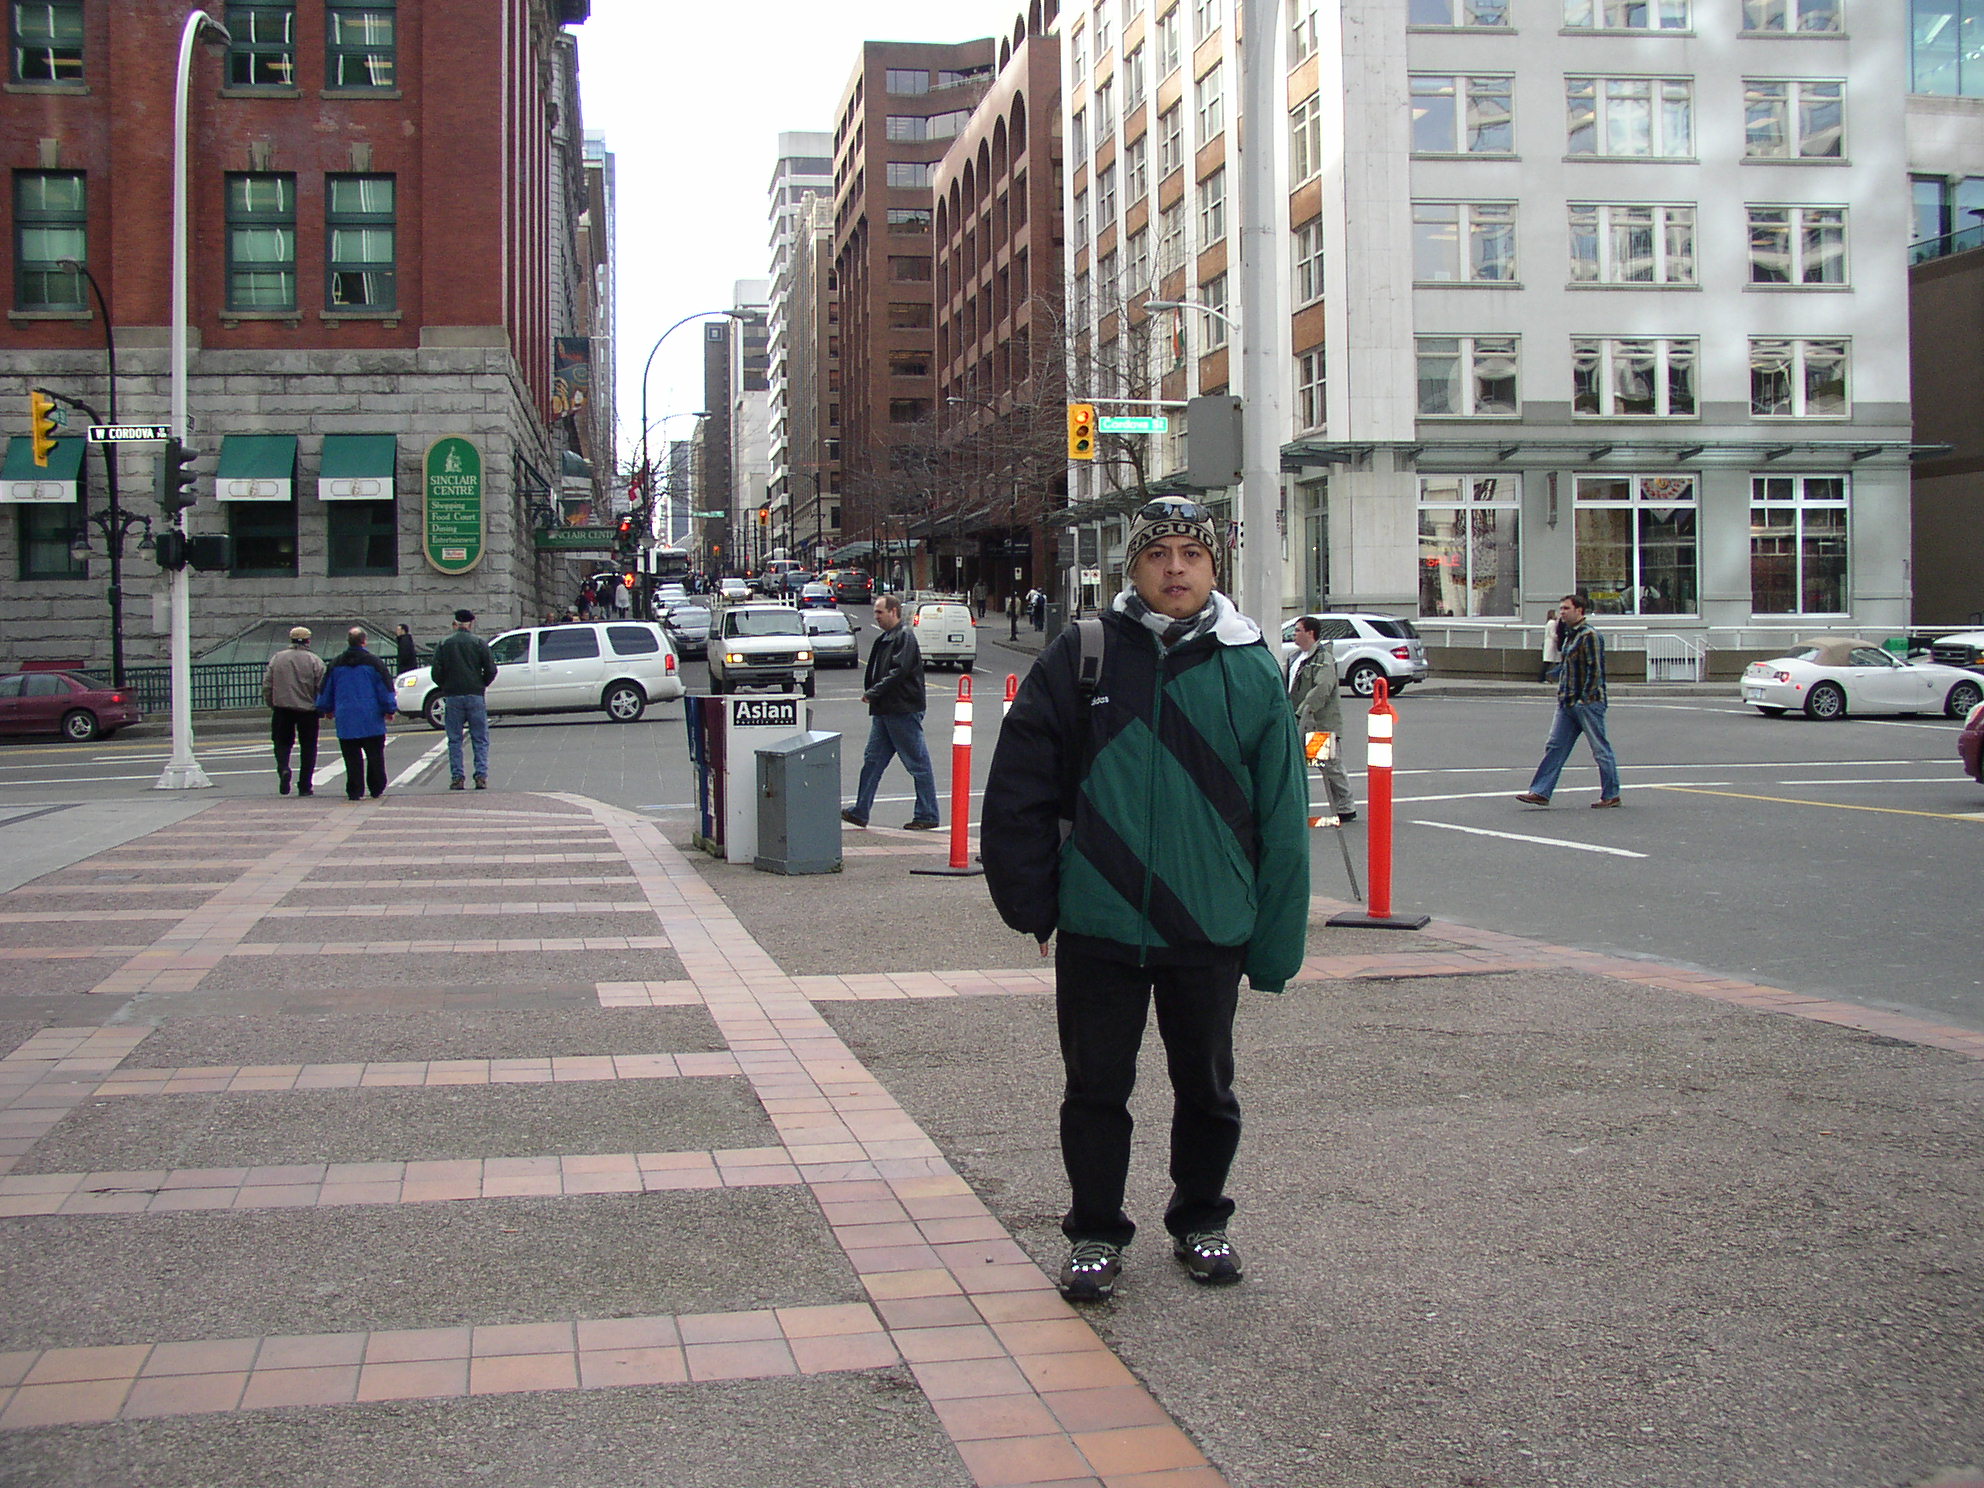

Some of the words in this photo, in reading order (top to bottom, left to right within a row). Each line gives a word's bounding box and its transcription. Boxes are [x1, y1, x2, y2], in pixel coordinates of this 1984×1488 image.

[95, 428, 105, 439] W
[109, 428, 154, 439] CORDOVA
[430, 475, 478, 485] SINCLAIR
[433, 486, 475, 496] CENTRE
[431, 501, 466, 510] Shopping
[432, 512, 451, 521] Food
[453, 512, 476, 521] Court
[432, 524, 457, 533] Dining
[432, 535, 477, 544] Entertainment
[736, 701, 793, 718] Asian
